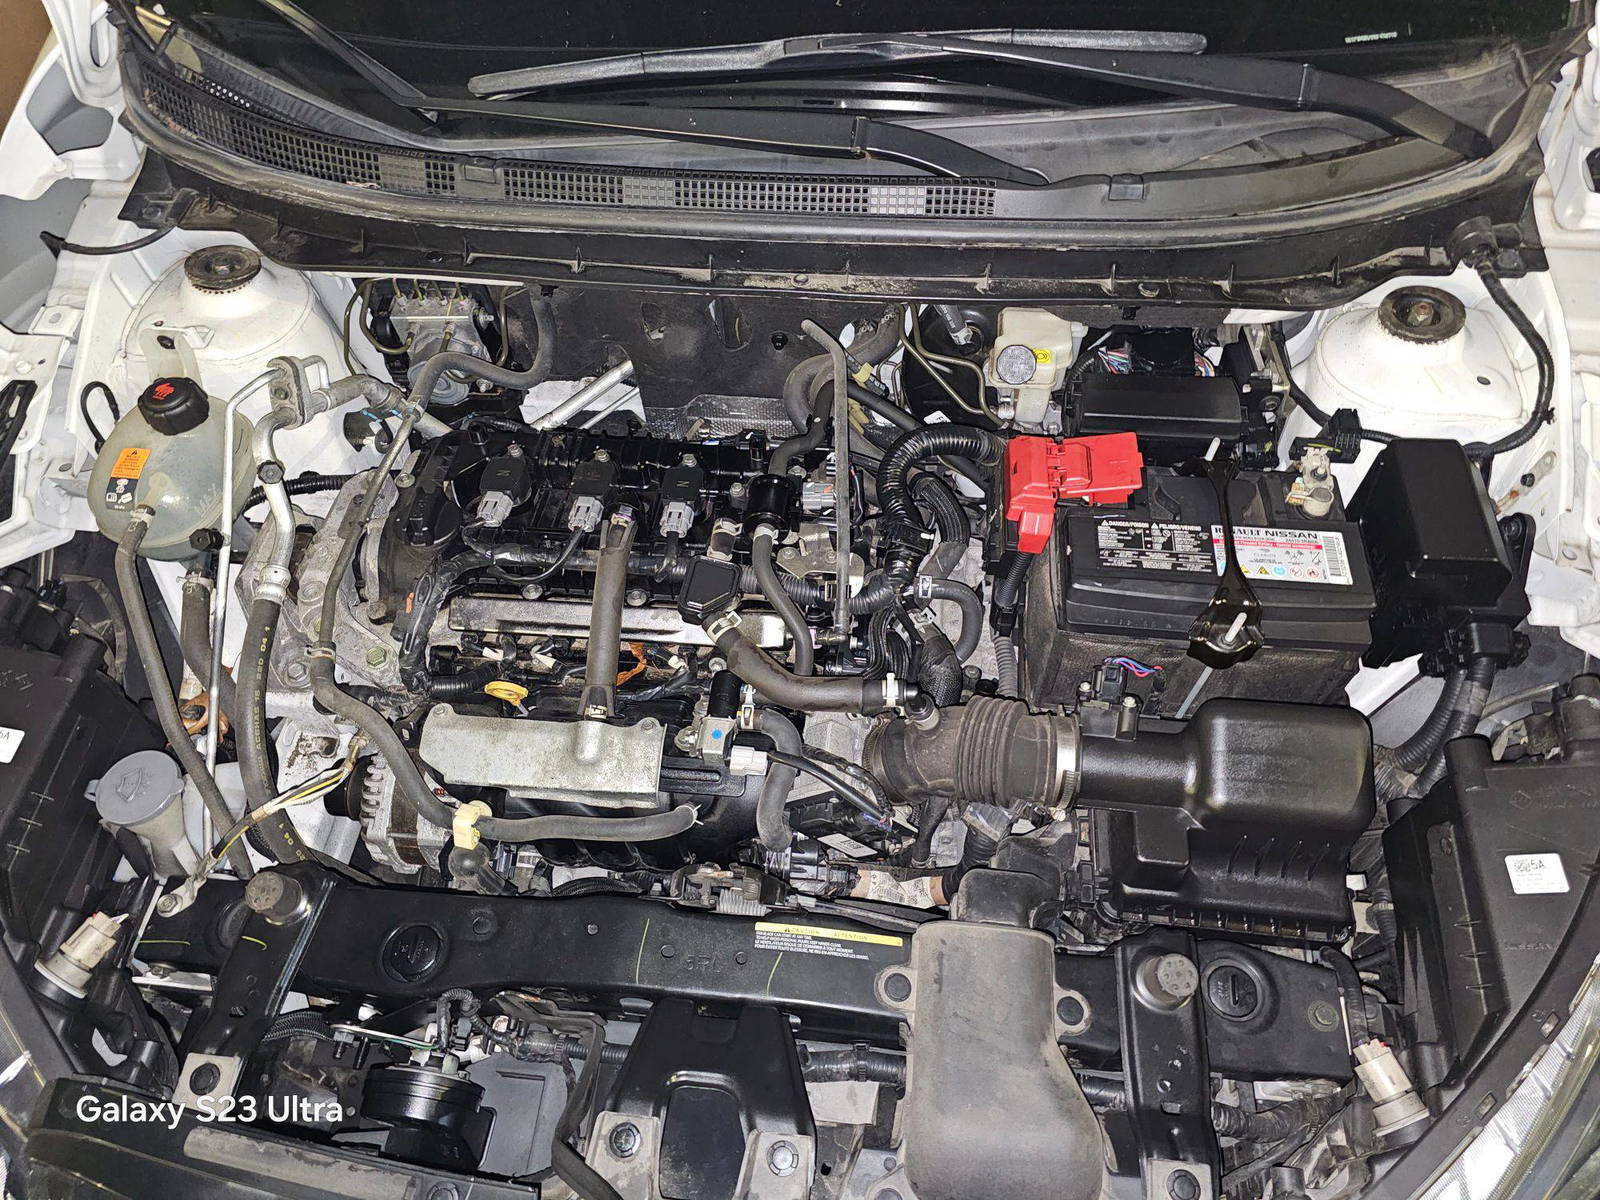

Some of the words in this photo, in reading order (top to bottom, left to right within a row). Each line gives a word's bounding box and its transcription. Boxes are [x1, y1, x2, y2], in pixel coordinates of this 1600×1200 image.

[1214, 527, 1260, 536] RAULT
[1264, 530, 1318, 539] NISSAN
[833, 931, 869, 941] ATTENTION
